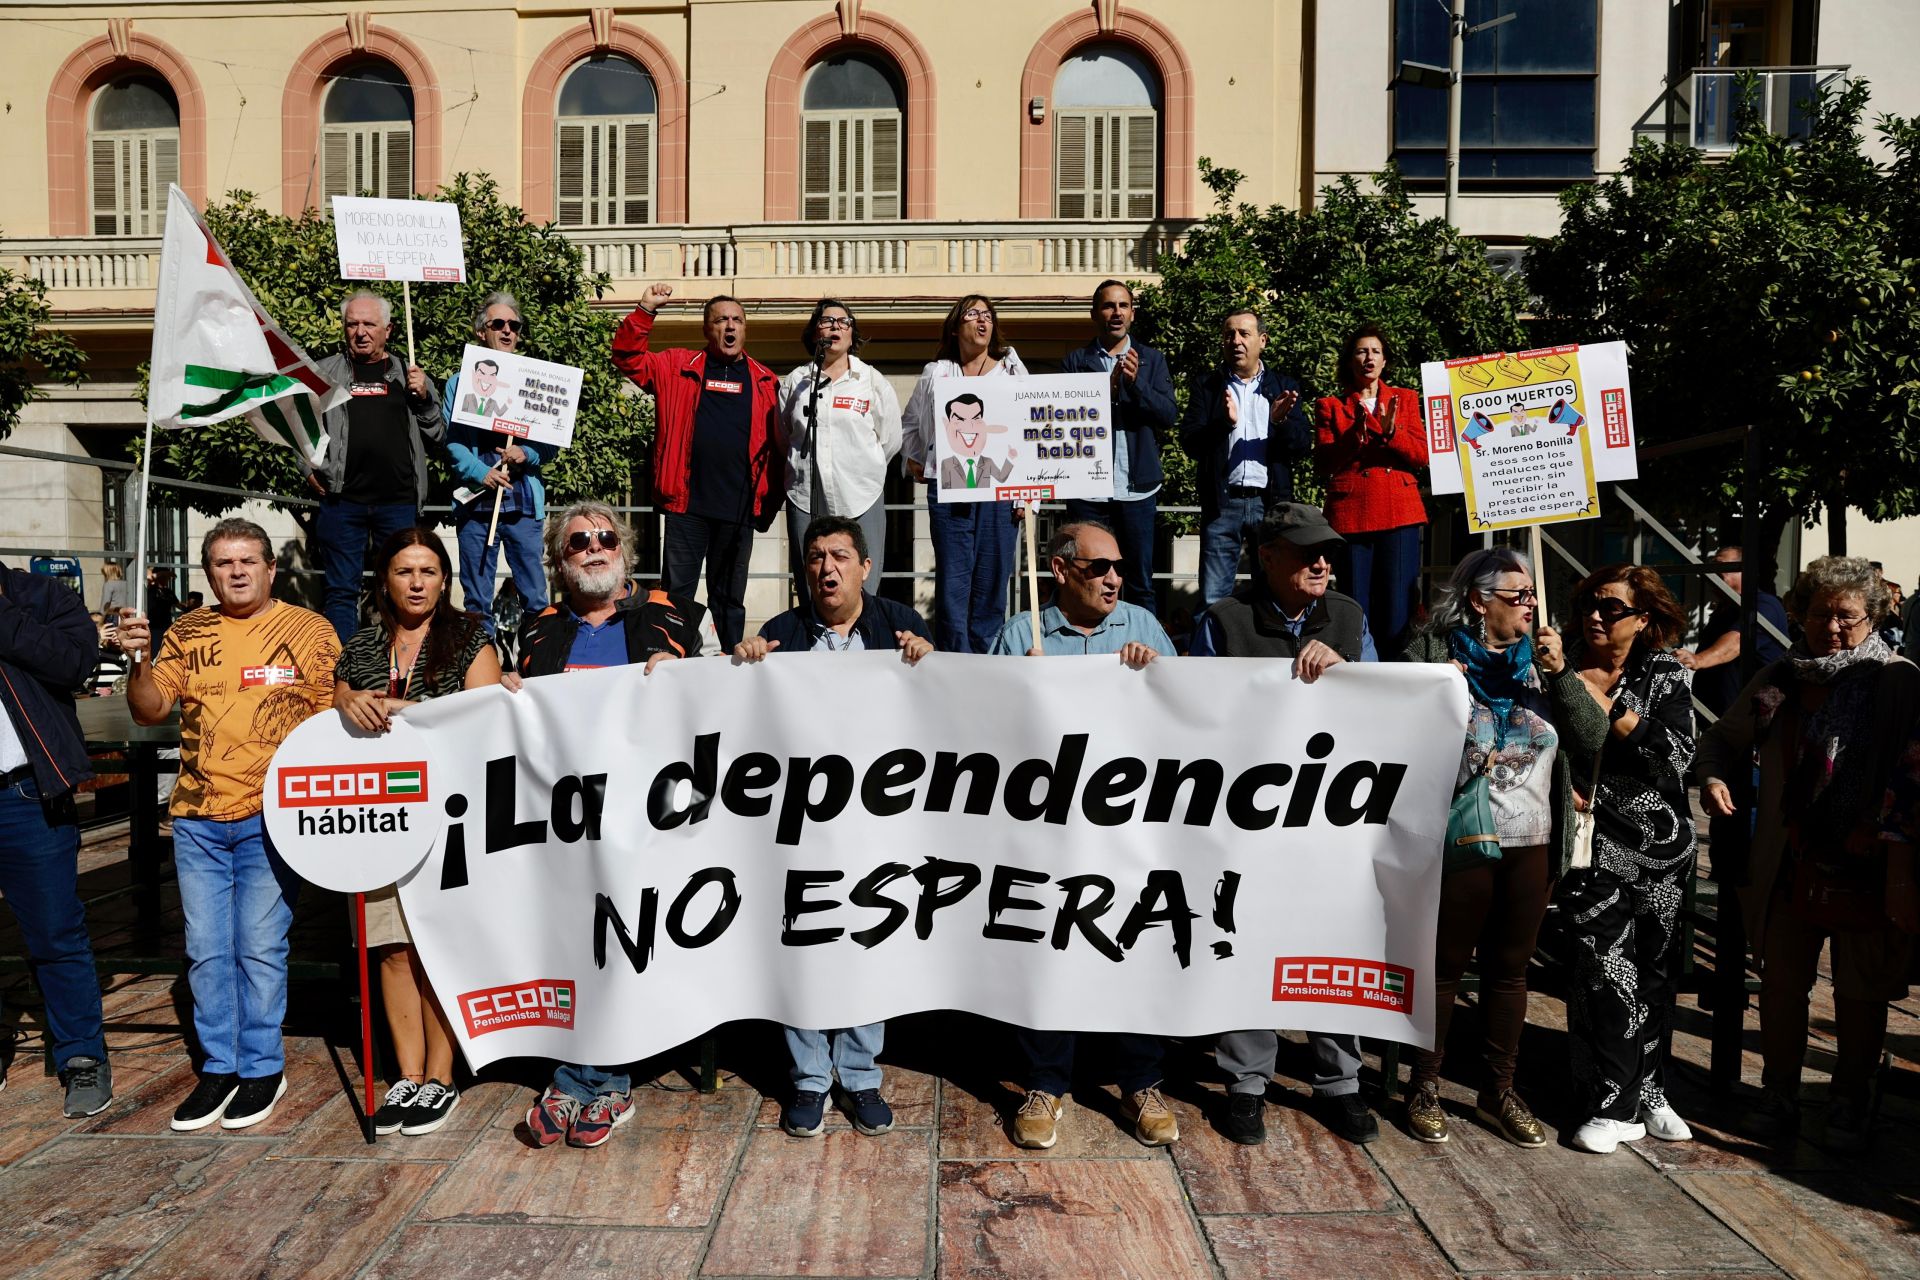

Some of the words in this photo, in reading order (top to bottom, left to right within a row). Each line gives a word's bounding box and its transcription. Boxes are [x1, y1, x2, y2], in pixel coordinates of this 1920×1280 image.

[345, 212, 394, 227] MORENO
[396, 214, 446, 229] BONILLA
[357, 231, 375, 246] NO
[405, 233, 448, 248] LISTAS
[368, 250, 384, 264] DE
[387, 250, 437, 265] ESPERA
[525, 377, 567, 396] Miente
[1015, 391, 1050, 402] JUANMA
[1064, 390, 1101, 399] BONILLA
[518, 388, 543, 401] más
[546, 395, 570, 408] que
[1462, 395, 1502, 411] 8.000
[1507, 384, 1574, 404] MUERTOS
[524, 399, 560, 417] habla
[1030, 404, 1099, 422] Miente
[1023, 423, 1064, 441] más
[1070, 425, 1107, 442] que
[1037, 441, 1095, 460] habla
[1476, 448, 1490, 458] Sr.
[1492, 443, 1533, 456] Moreno
[1536, 436, 1573, 449] Bonilla
[1490, 458, 1518, 467] esos
[1522, 454, 1544, 463] son
[1548, 450, 1566, 459] los
[1482, 462, 1546, 478] andaluces
[1550, 460, 1573, 472] que
[1548, 470, 1566, 479] sin
[999, 488, 1041, 500] CCOO
[1488, 492, 1556, 509] prestación
[1559, 490, 1575, 498] en
[1502, 484, 1544, 496] recibir
[1483, 508, 1517, 519] listas
[1520, 504, 1536, 513] de
[1539, 499, 1583, 512] espera
[285, 772, 380, 799] CCOO
[440, 754, 608, 891] ¡La
[646, 731, 1408, 846] dependencia
[298, 806, 409, 836] hábitat
[594, 866, 742, 973] NO
[780, 855, 1241, 970] ESPERA!
[1281, 963, 1381, 990] CCOO
[467, 986, 557, 1018] CCOO
[1280, 985, 1353, 998] Pensionistas
[1363, 989, 1404, 1006] Málaga
[473, 1010, 541, 1029] Pensionistas
[547, 1009, 571, 1022] Málaga
